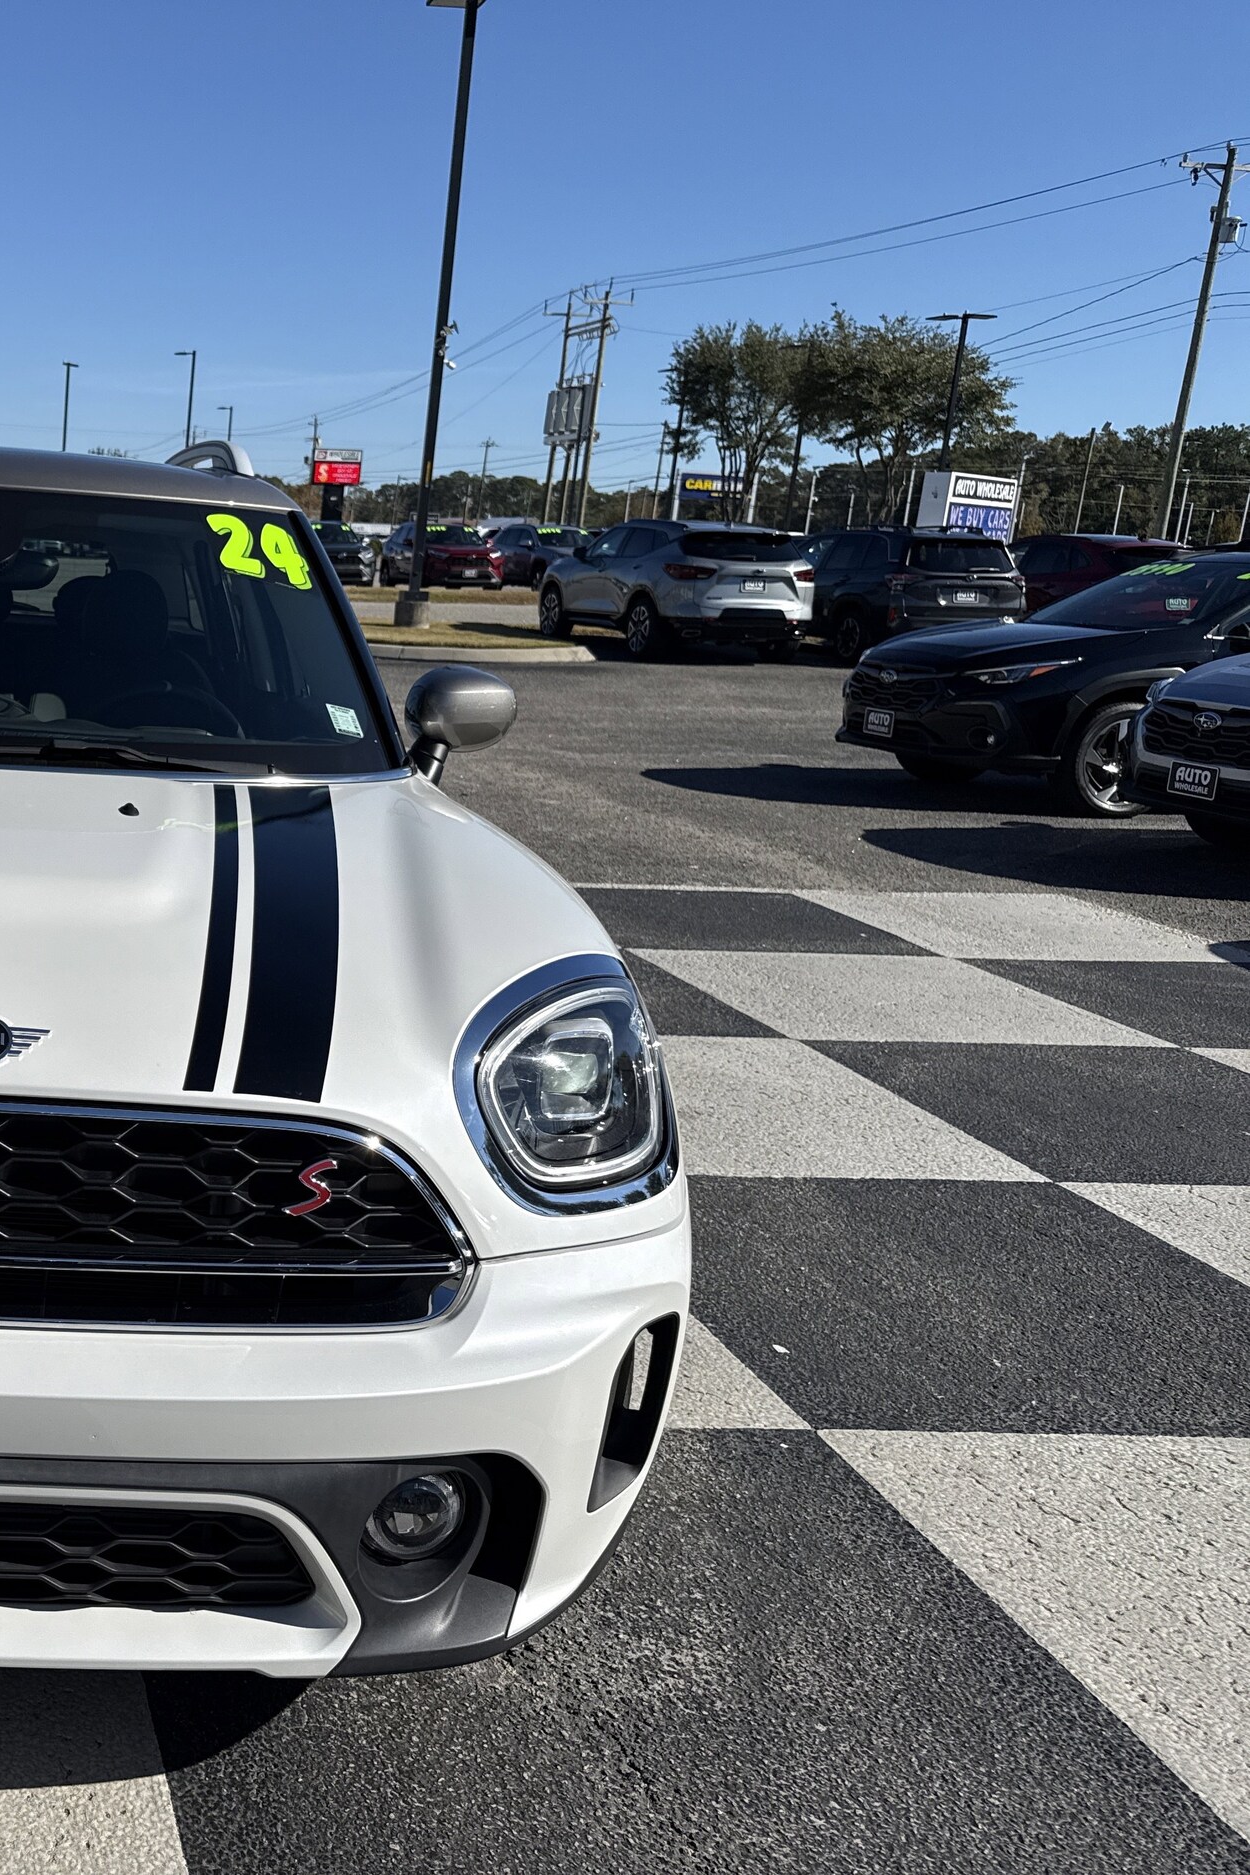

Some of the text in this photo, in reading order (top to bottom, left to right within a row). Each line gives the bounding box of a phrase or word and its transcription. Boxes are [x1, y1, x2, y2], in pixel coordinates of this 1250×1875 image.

[955, 479, 1015, 500] AUTO WHOLESALE
[950, 505, 1010, 530] WE BUY CARS
[206, 513, 313, 590] 24
[868, 711, 890, 726] AUTO
[1175, 766, 1212, 786] AUTO
[1174, 781, 1209, 795] WHOLESALE
[281, 1158, 338, 1217] S
